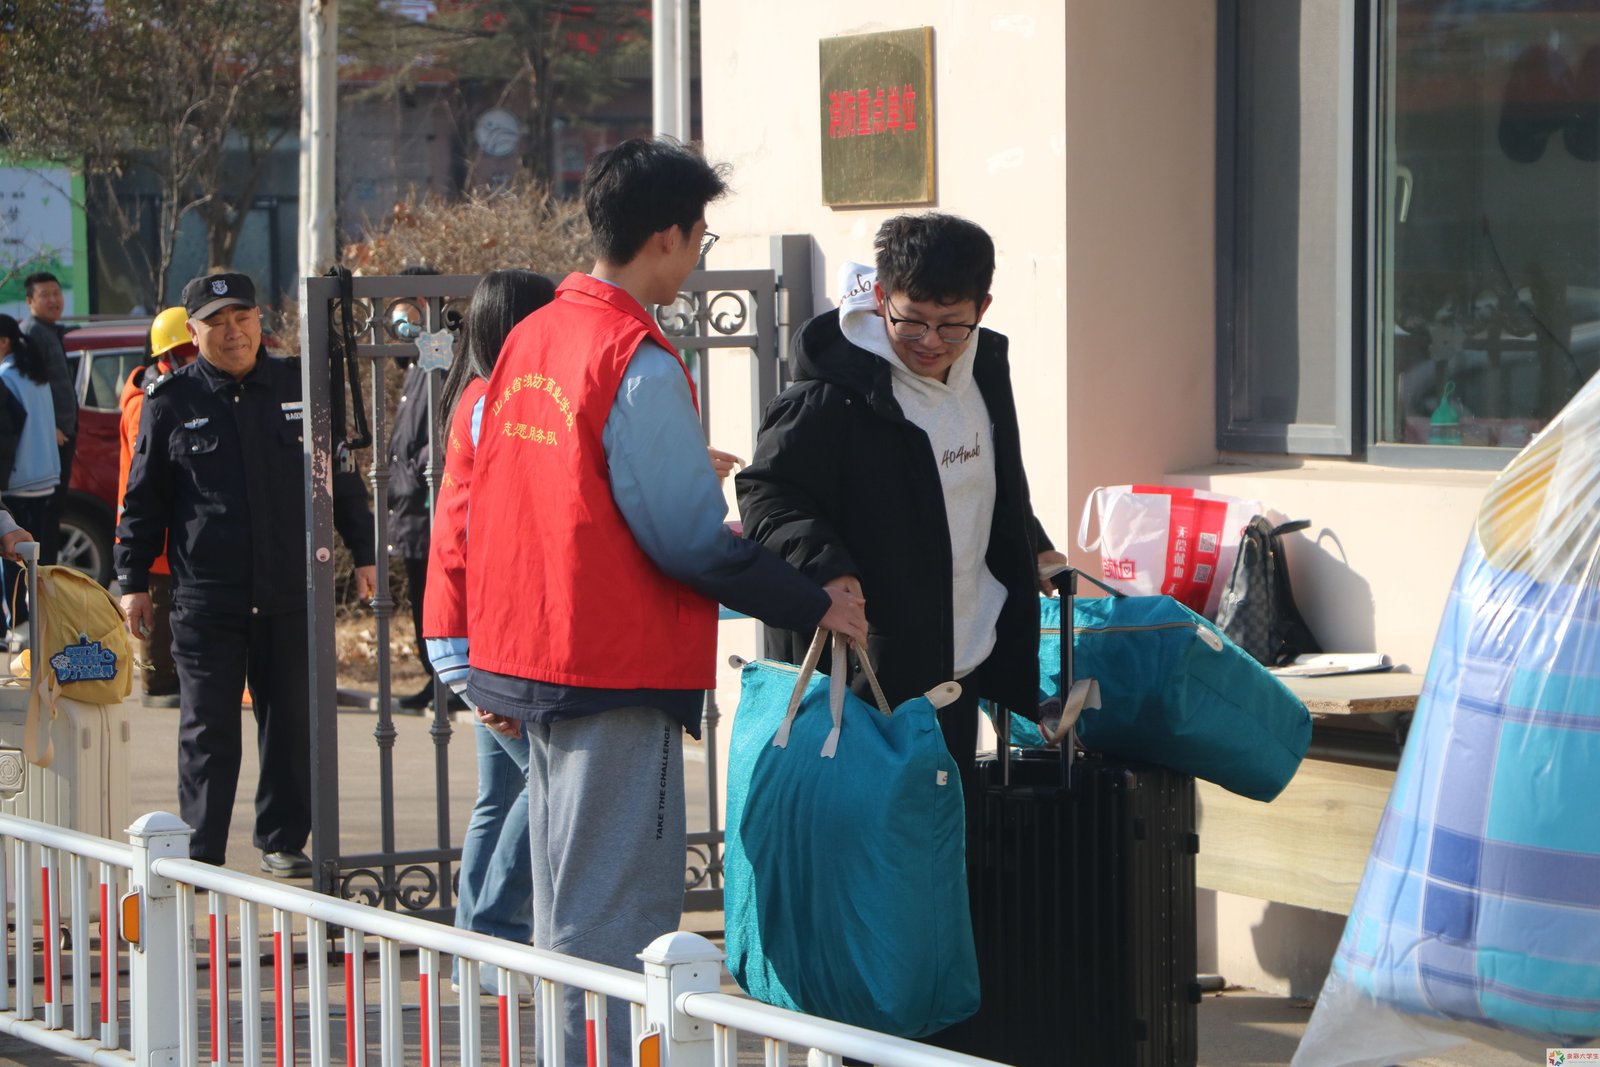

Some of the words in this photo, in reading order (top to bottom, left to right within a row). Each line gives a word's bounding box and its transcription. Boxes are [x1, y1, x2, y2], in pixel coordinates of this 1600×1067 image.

[828, 84, 917, 138] 消防重点单位
[502, 421, 558, 446] 志愿服务队
[1173, 526, 1189, 579] 无偿献血
[656, 813, 664, 840] TAKE
[660, 724, 671, 788] CHALLENGE
